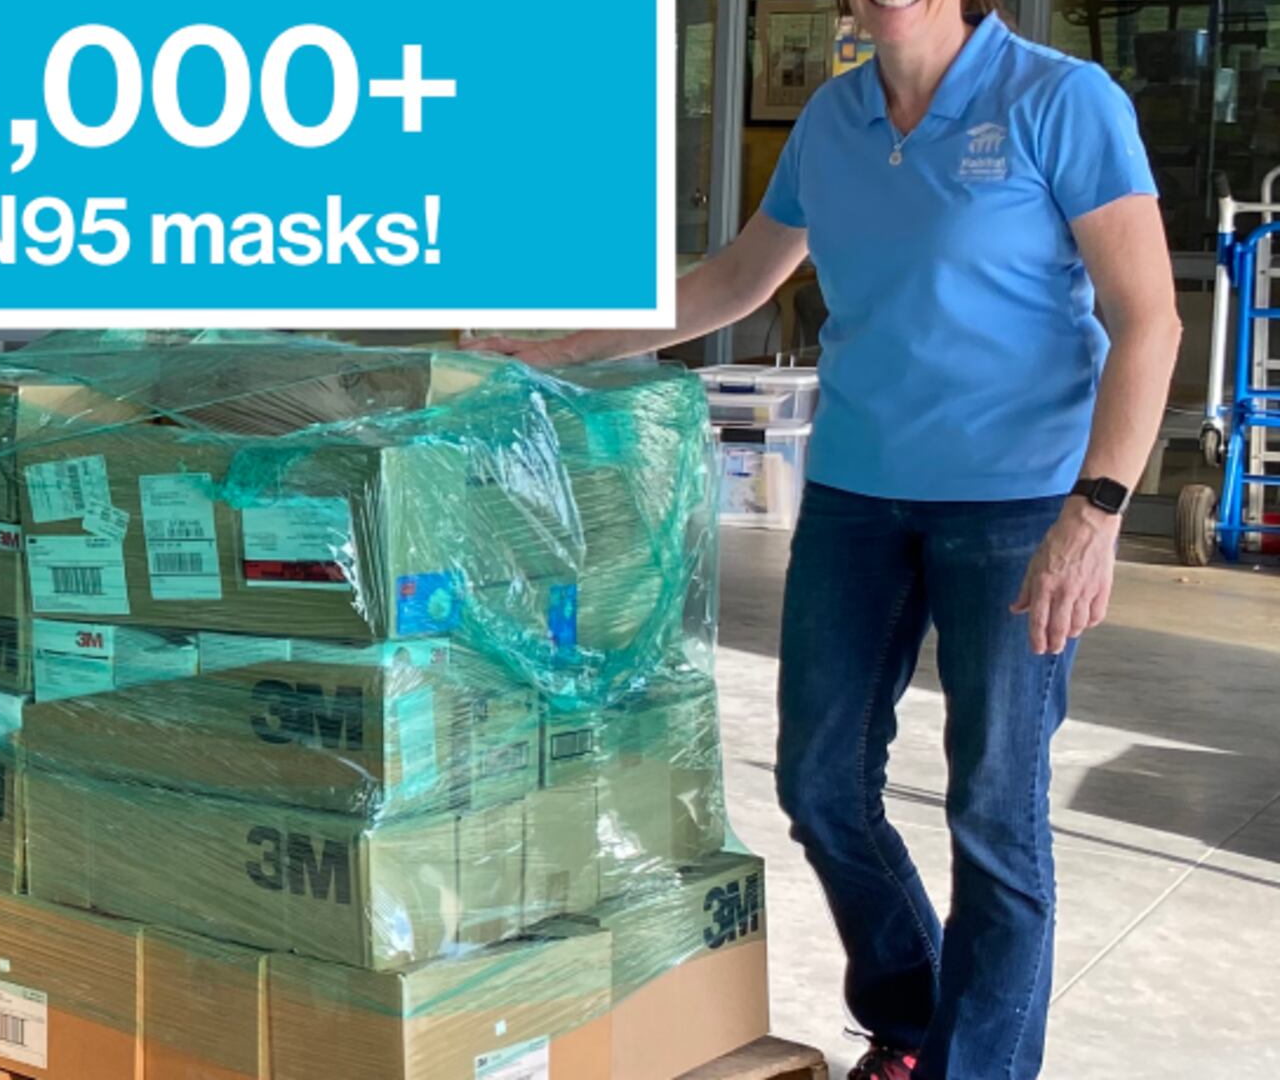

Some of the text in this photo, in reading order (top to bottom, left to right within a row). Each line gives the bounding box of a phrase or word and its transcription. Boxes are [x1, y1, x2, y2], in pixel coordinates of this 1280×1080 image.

[75, 630, 104, 649] 3M
[250, 678, 365, 751] 3M
[245, 826, 353, 905] 3M
[702, 872, 764, 951] 3M
